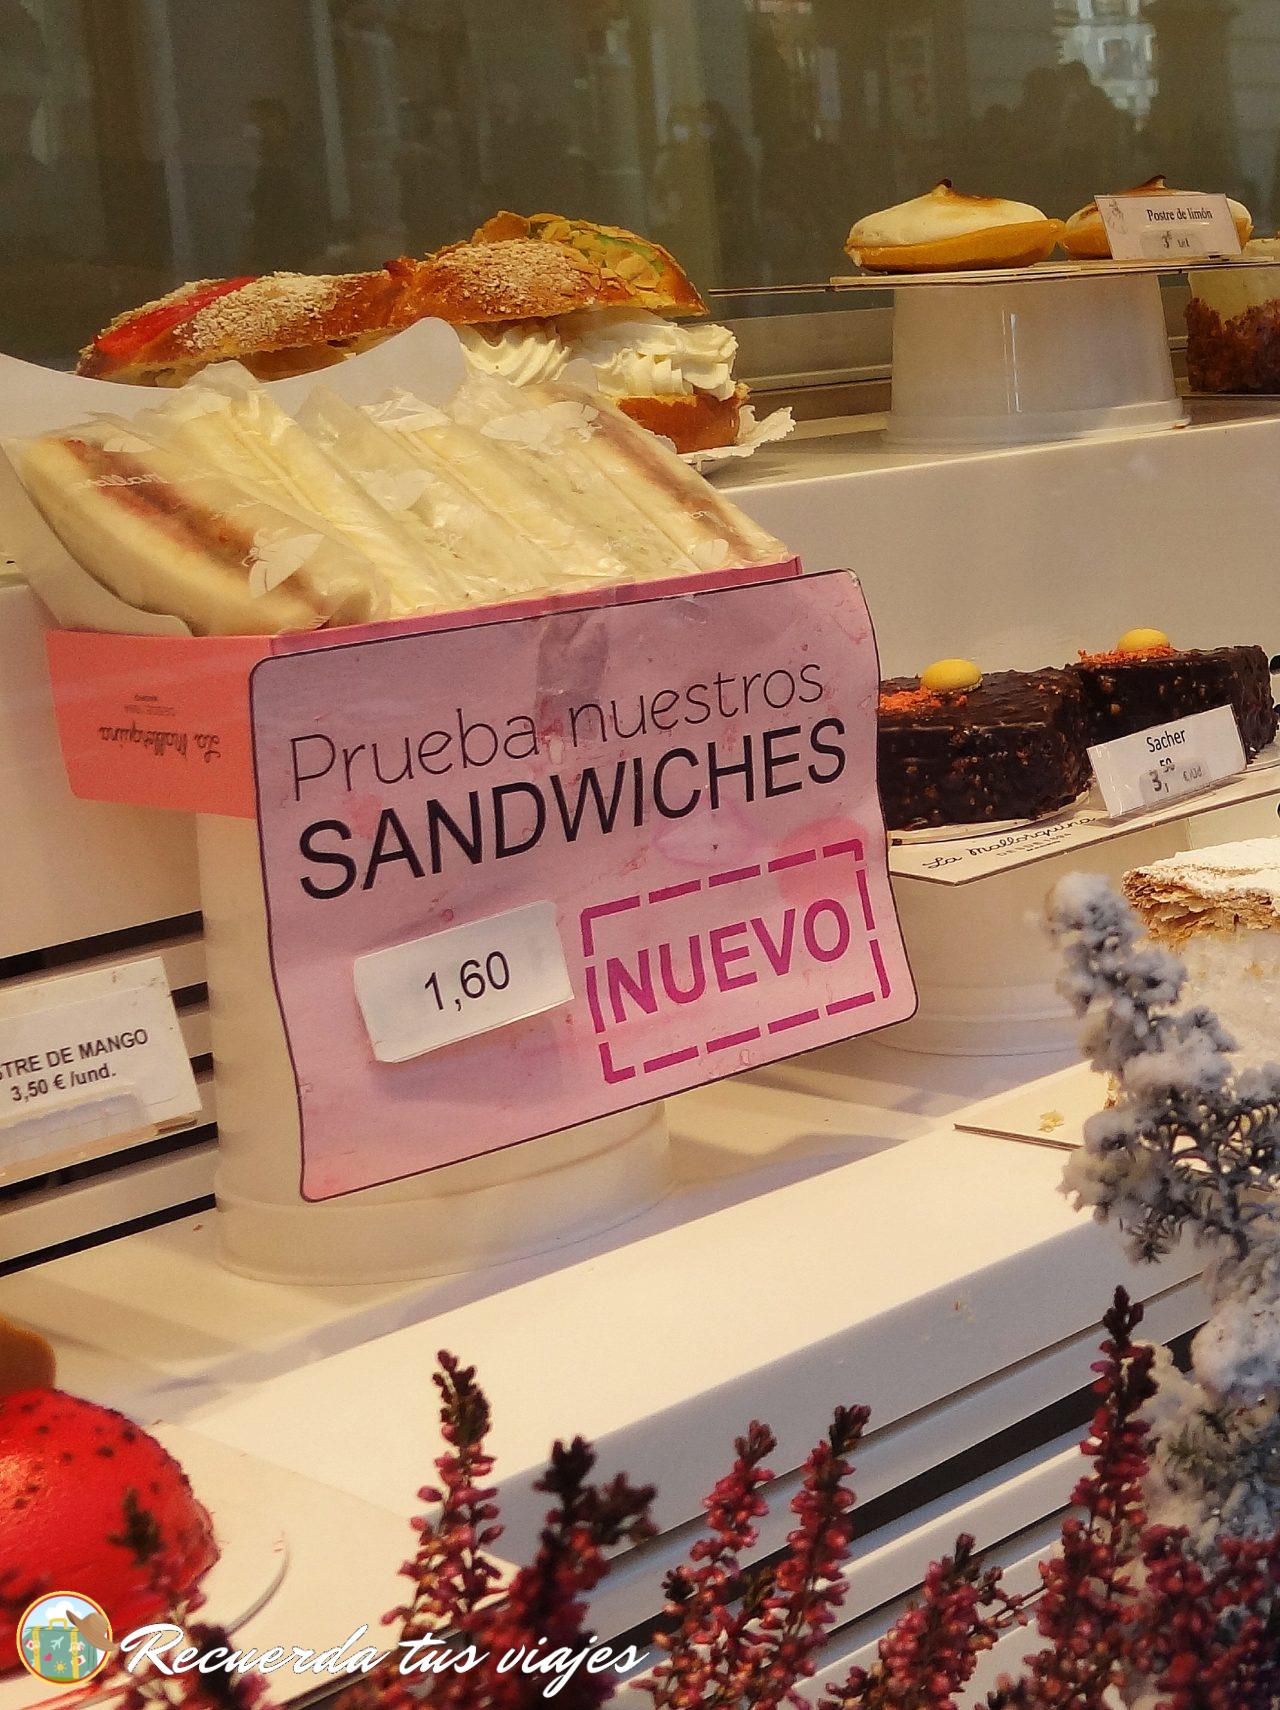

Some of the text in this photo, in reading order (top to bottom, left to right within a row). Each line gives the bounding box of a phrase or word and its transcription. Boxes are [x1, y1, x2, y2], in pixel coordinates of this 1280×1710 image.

[1147, 207, 1213, 221] Postre de limón
[290, 663, 824, 802] Prueba nuestros
[1146, 729, 1186, 753] Sacher
[299, 717, 846, 900] SANDWICHES
[922, 856, 962, 870] La
[967, 817, 1096, 857] Mallorquina
[424, 951, 510, 1012] 1,60
[606, 898, 850, 1024] NUEVO
[46, 1046, 74, 1068] DE
[78, 1028, 148, 1060] MANGO
[11, 1063, 117, 1103] 3,50 € /und.
